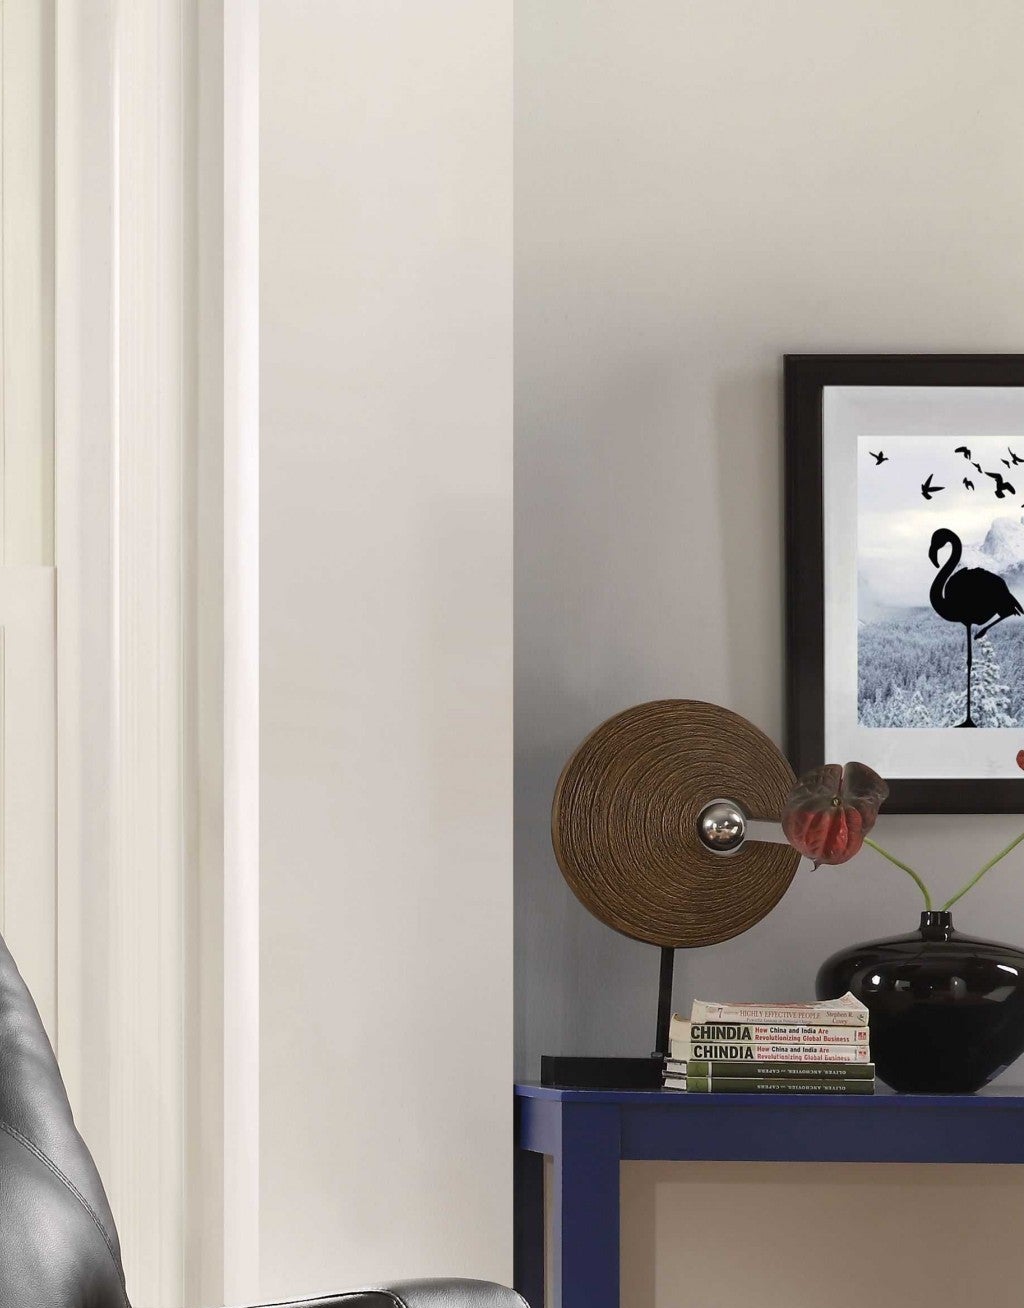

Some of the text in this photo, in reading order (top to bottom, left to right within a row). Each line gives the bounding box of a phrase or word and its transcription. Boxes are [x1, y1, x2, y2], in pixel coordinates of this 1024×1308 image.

[717, 1007, 723, 1018] 7
[690, 1025, 752, 1040] CHINDIA
[693, 1045, 754, 1059] CHINDIA
